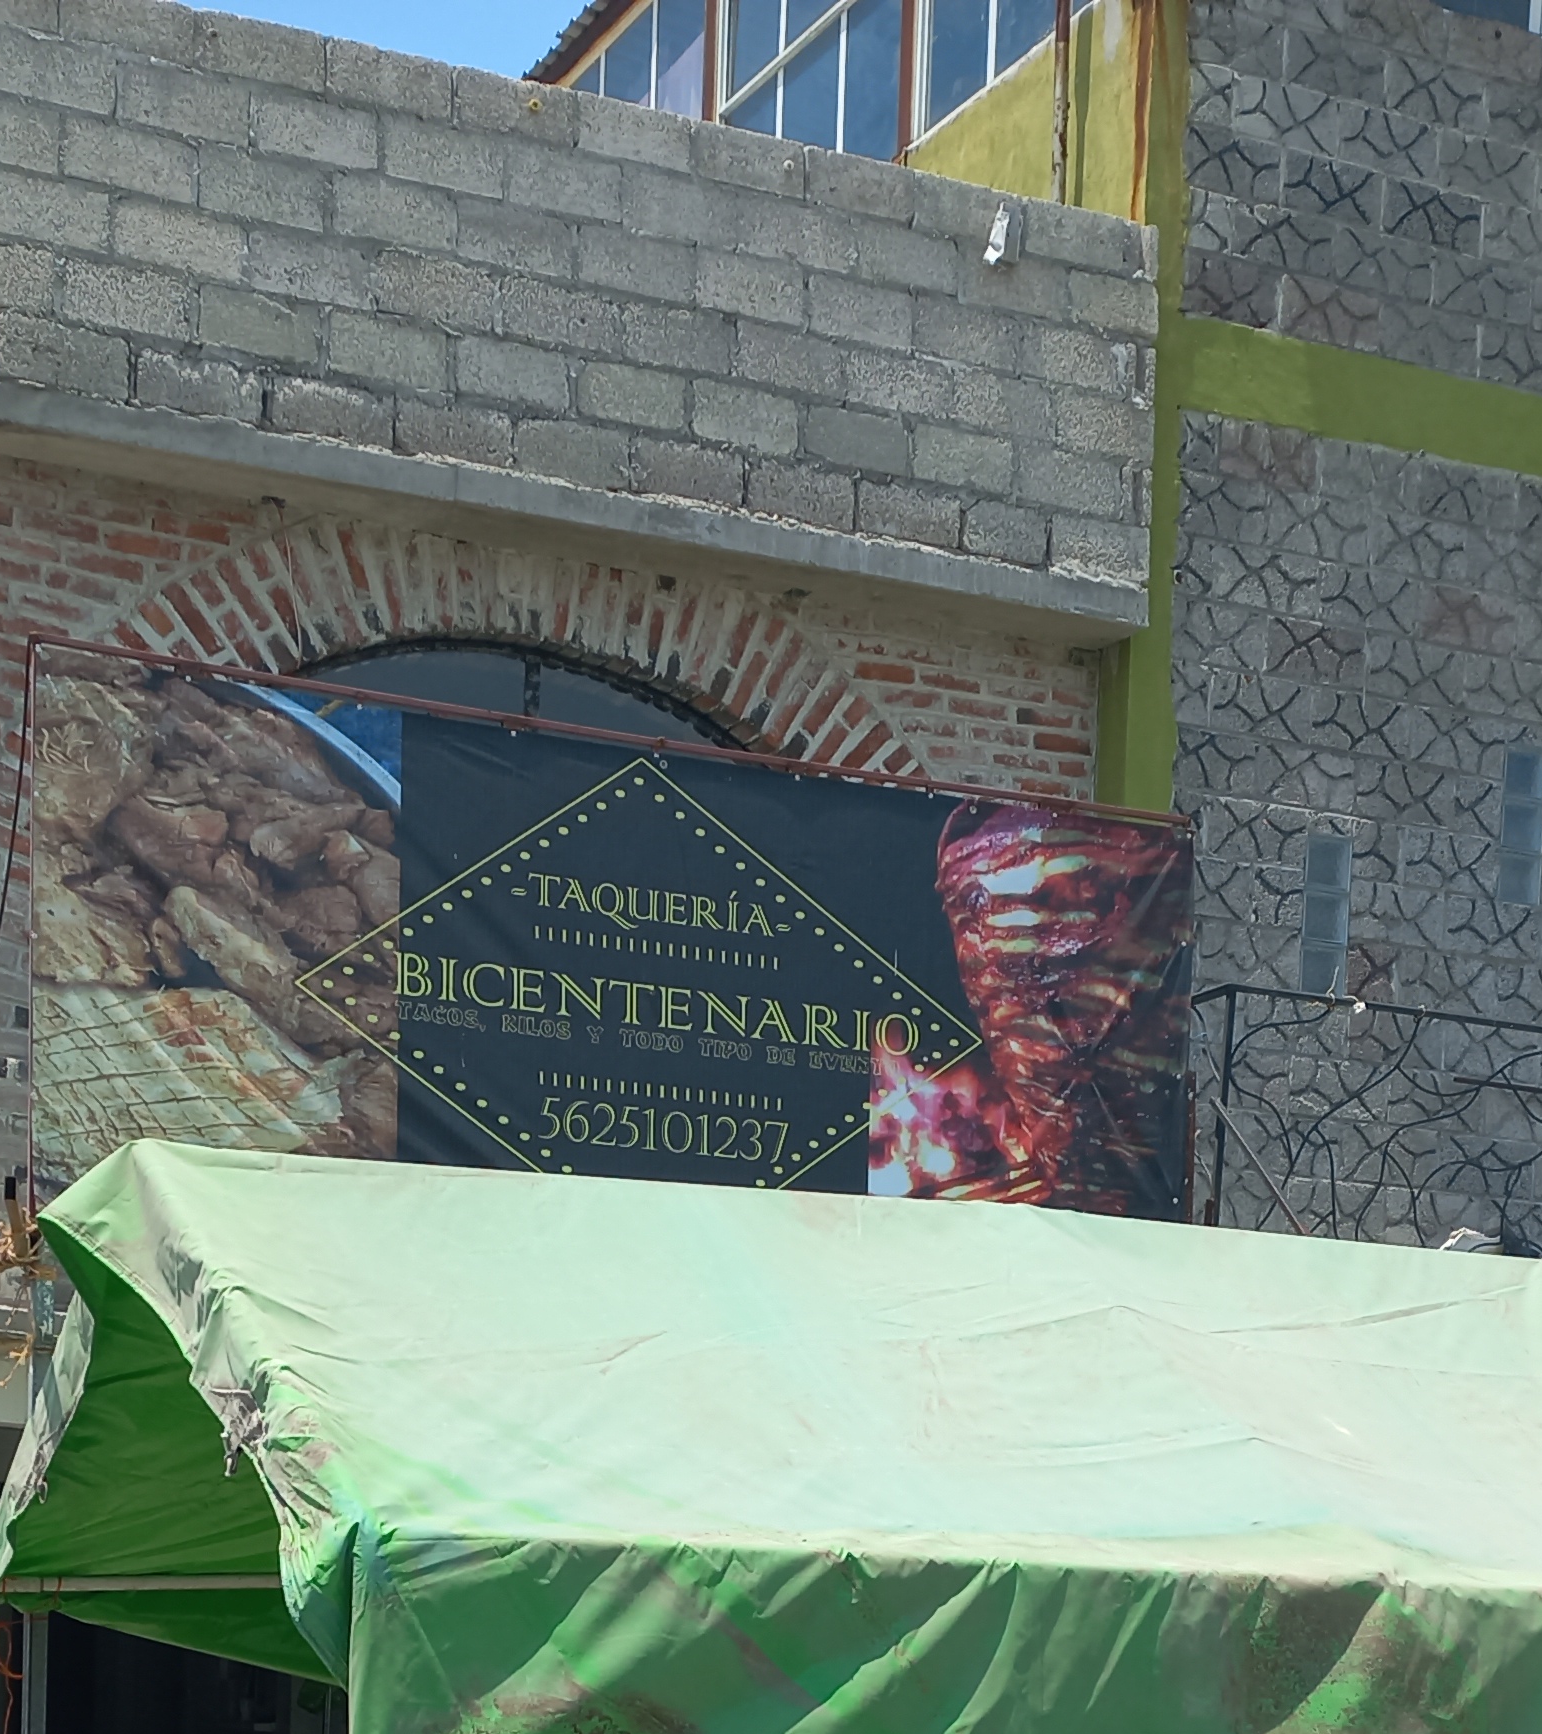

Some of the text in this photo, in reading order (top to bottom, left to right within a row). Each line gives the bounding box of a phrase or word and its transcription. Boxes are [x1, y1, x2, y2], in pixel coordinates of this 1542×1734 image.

[393, 952, 920, 1058] BICENTENARIO
[395, 1000, 486, 1032] TACOS,
[502, 1014, 572, 1040] KILOS
[586, 1025, 604, 1044] Y
[619, 1028, 684, 1054] TODO
[698, 1037, 752, 1061] TIPO
[766, 1045, 796, 1066] DE
[538, 1095, 789, 1165] 5625101237
